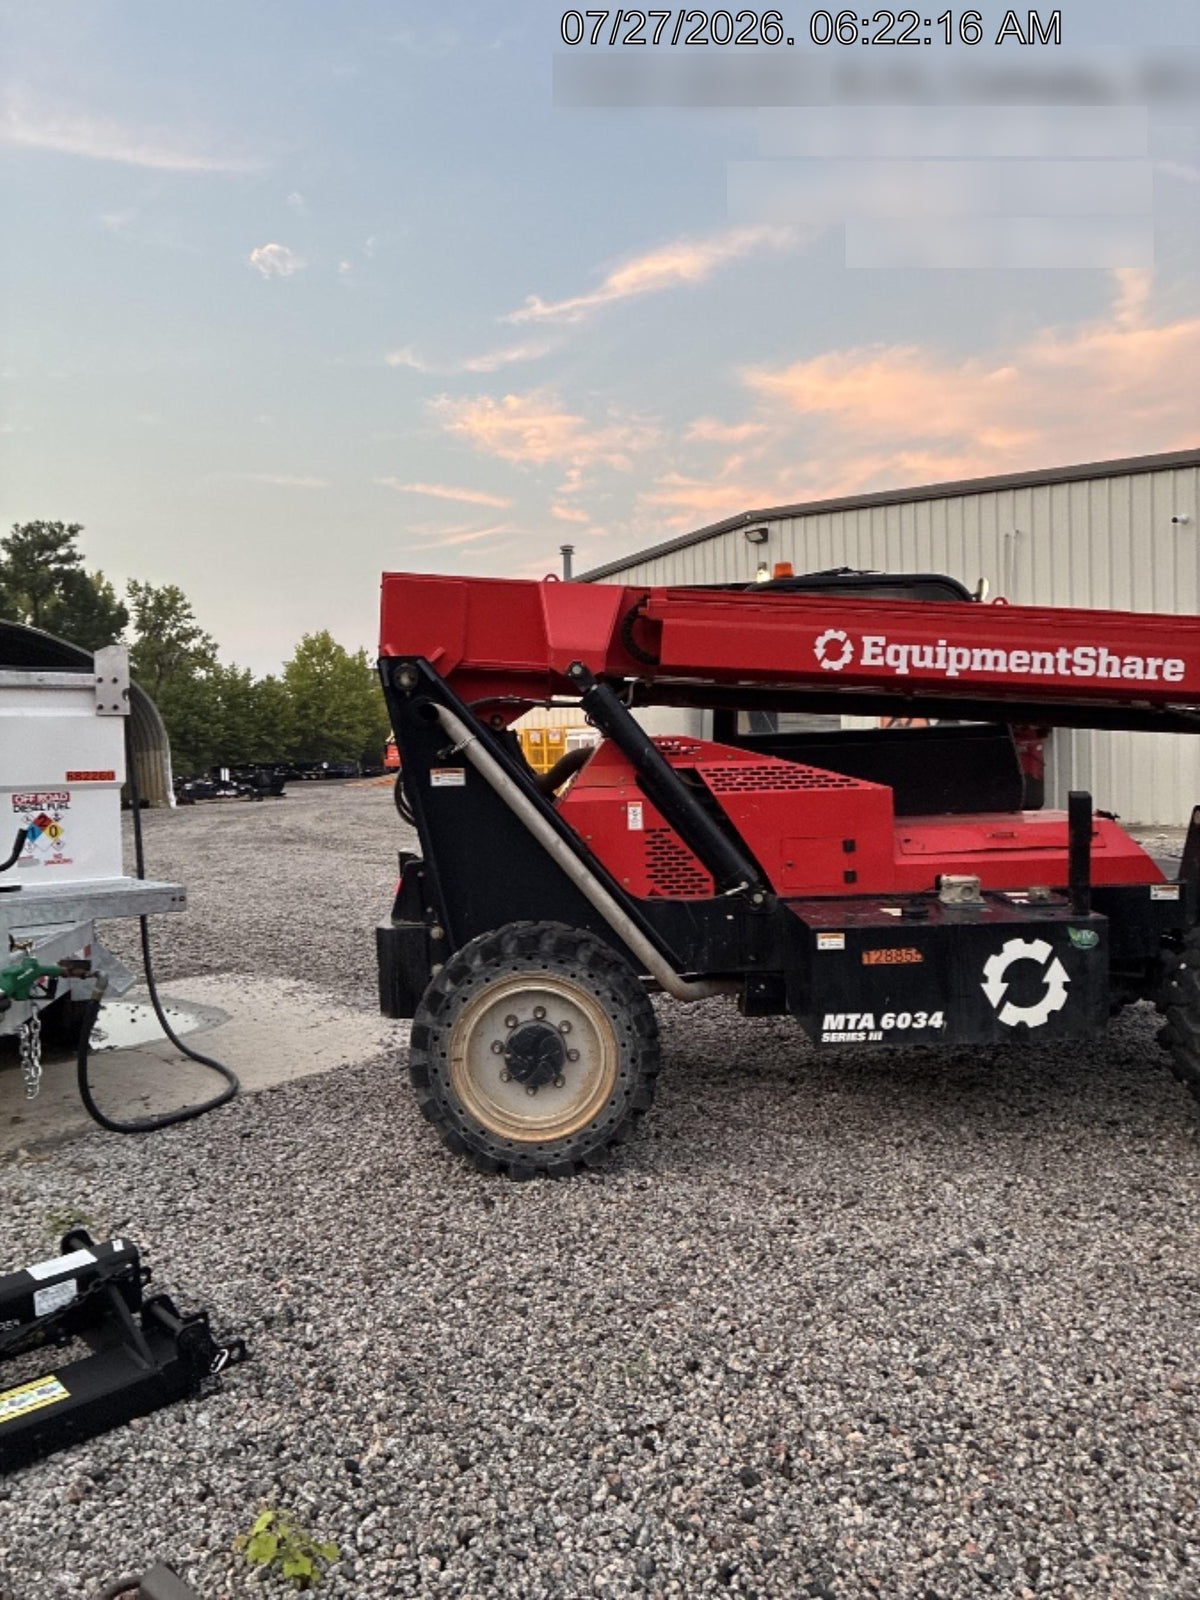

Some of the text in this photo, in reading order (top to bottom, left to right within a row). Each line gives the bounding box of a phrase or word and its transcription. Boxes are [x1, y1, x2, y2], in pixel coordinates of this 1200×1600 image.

[860, 635, 1185, 682] EquipmentShare
[14, 793, 67, 804] OFF ROAD
[13, 803, 70, 813] DIESEL FUEL
[822, 1011, 944, 1030] MTA 6034
[821, 1031, 883, 1042] SERIES III
